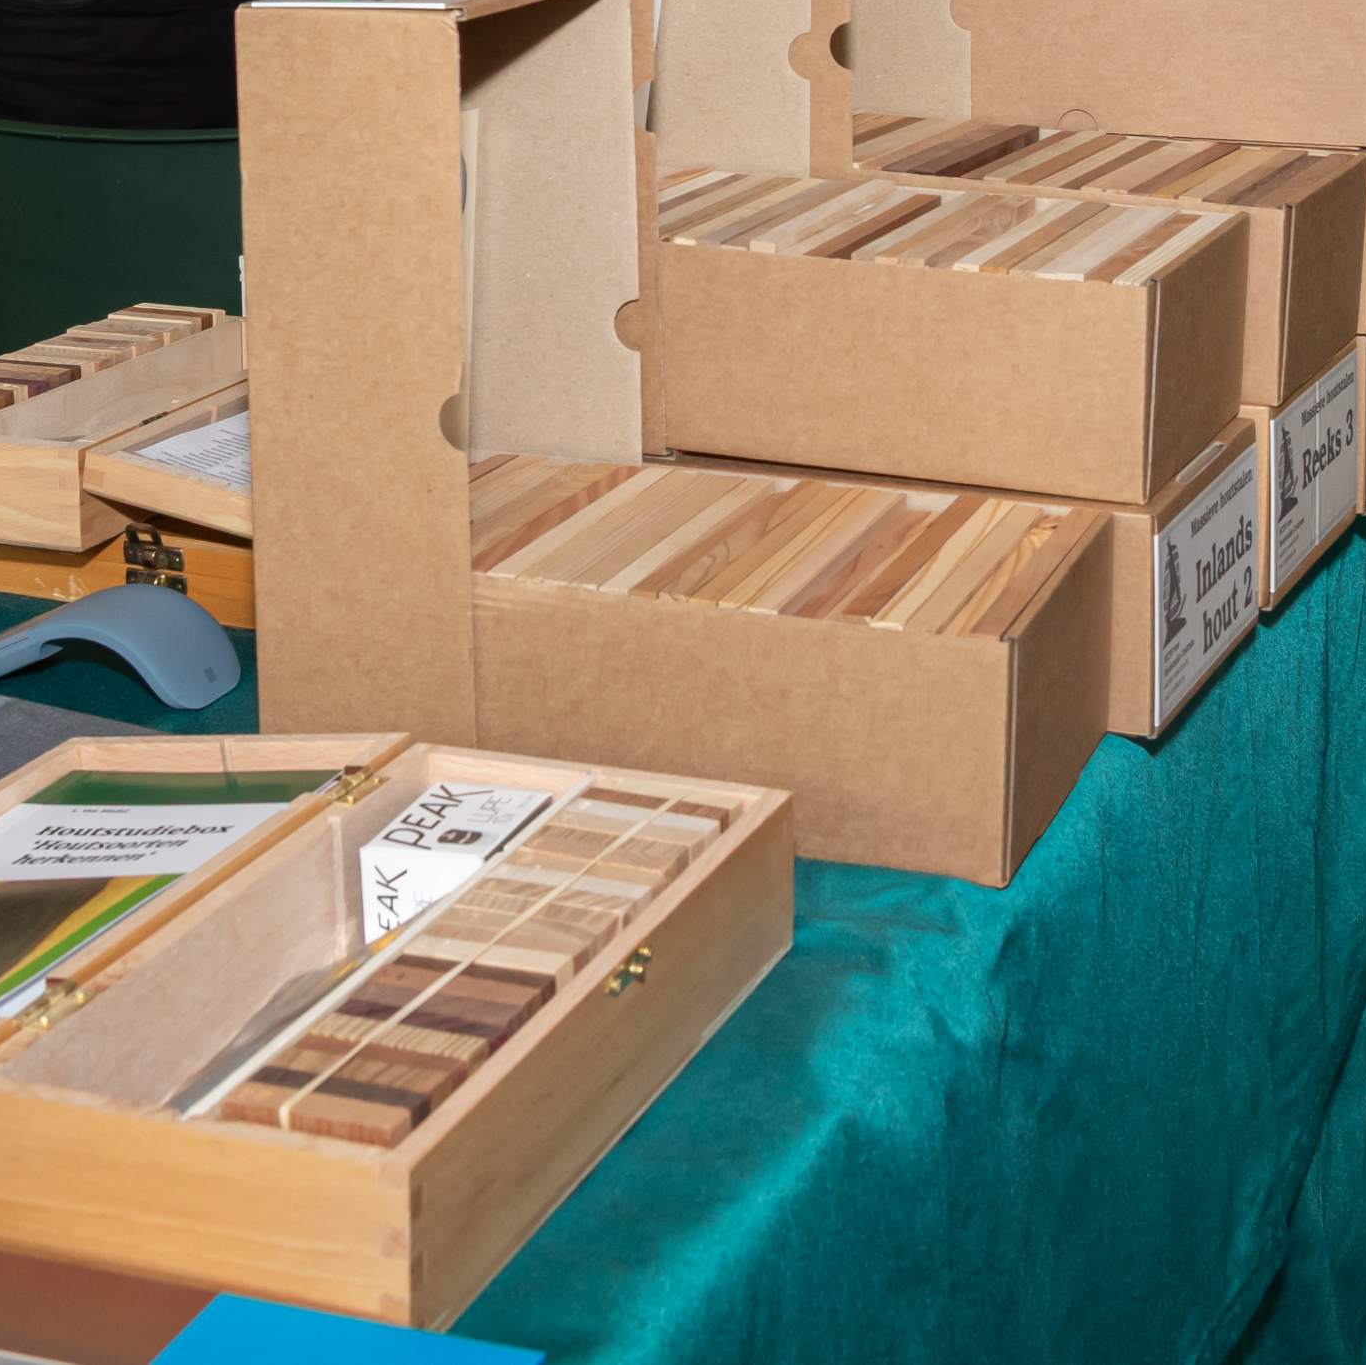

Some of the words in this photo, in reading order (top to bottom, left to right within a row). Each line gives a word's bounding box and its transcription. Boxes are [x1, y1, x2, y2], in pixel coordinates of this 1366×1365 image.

[1302, 426, 1341, 490] Reeks
[1345, 408, 1354, 447] 3
[1195, 514, 1253, 604] Inlands
[1202, 578, 1239, 654] hout
[1243, 565, 1253, 609] 2
[35, 823, 235, 837] Houtstudiebox
[382, 783, 495, 851] PEAK
[374, 864, 408, 931] EAK
